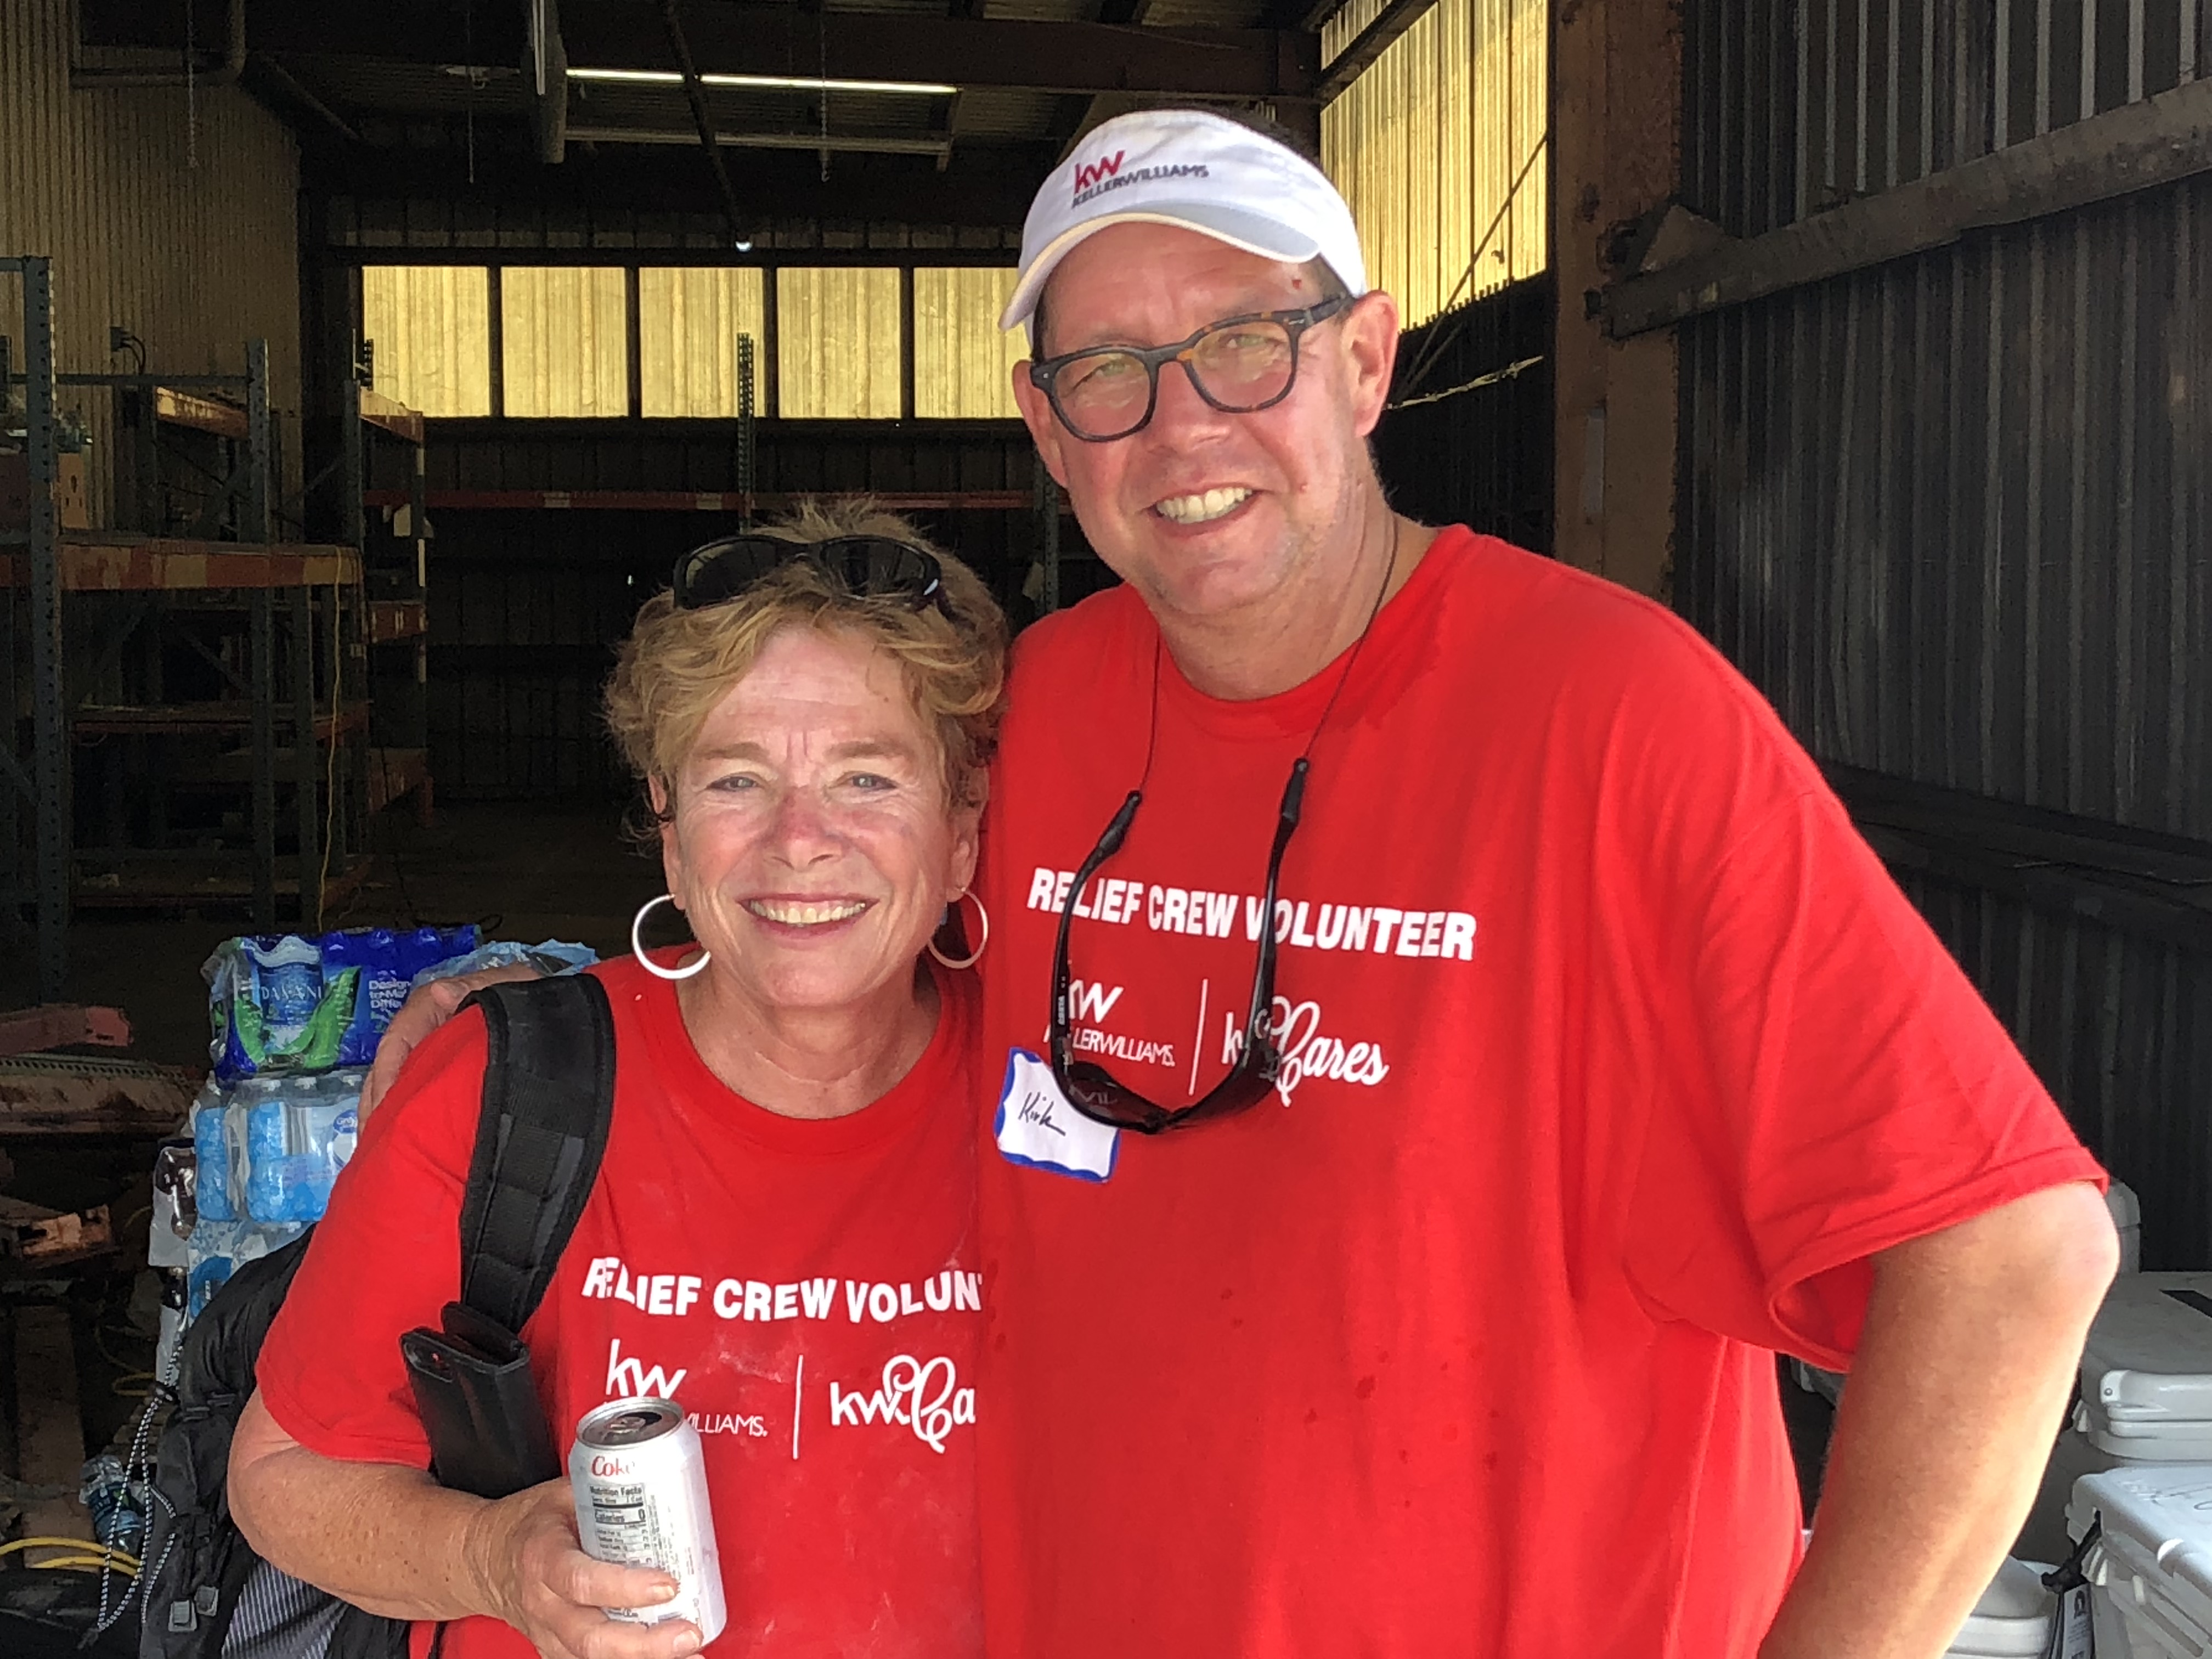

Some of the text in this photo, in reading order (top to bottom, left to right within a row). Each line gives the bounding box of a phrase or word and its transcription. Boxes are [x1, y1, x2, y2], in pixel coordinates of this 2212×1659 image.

[1075, 150, 1125, 194] kw
[1027, 867, 1477, 961] RELIEF CREW VOLUNTEER
[1018, 1091, 1066, 1137] Kirk
[580, 1256, 983, 1323] RELIEF CREW VOLUN
[605, 1338, 687, 1400] kw
